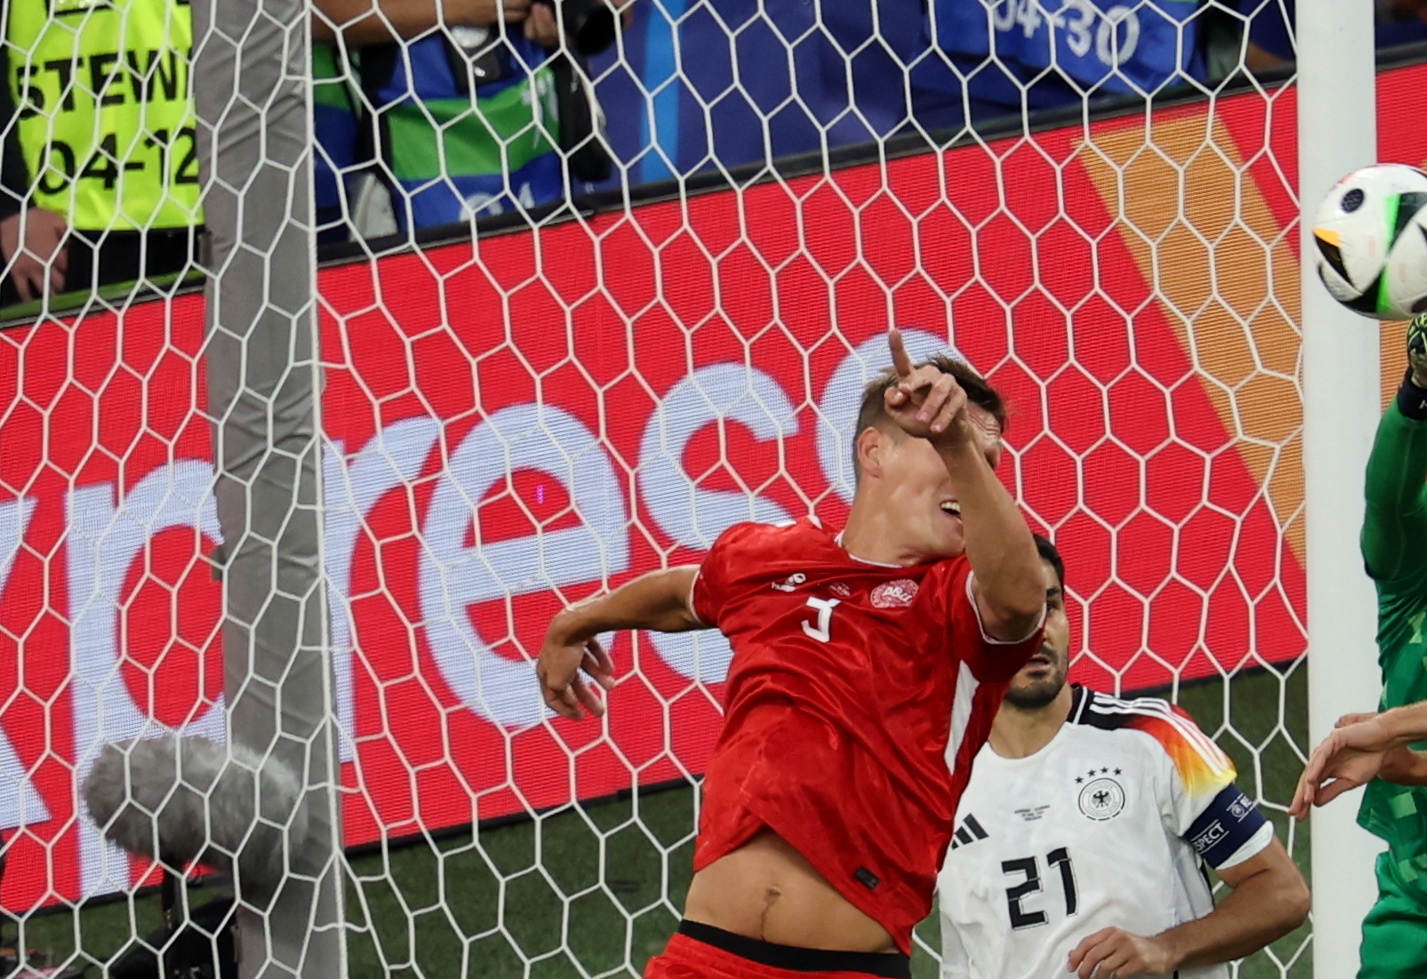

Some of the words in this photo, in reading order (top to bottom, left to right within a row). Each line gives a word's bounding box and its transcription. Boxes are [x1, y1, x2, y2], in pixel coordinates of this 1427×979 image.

[15, 47, 193, 120] STEW
[1192, 822, 1225, 852] SPECT
[1001, 847, 1079, 930] 21
